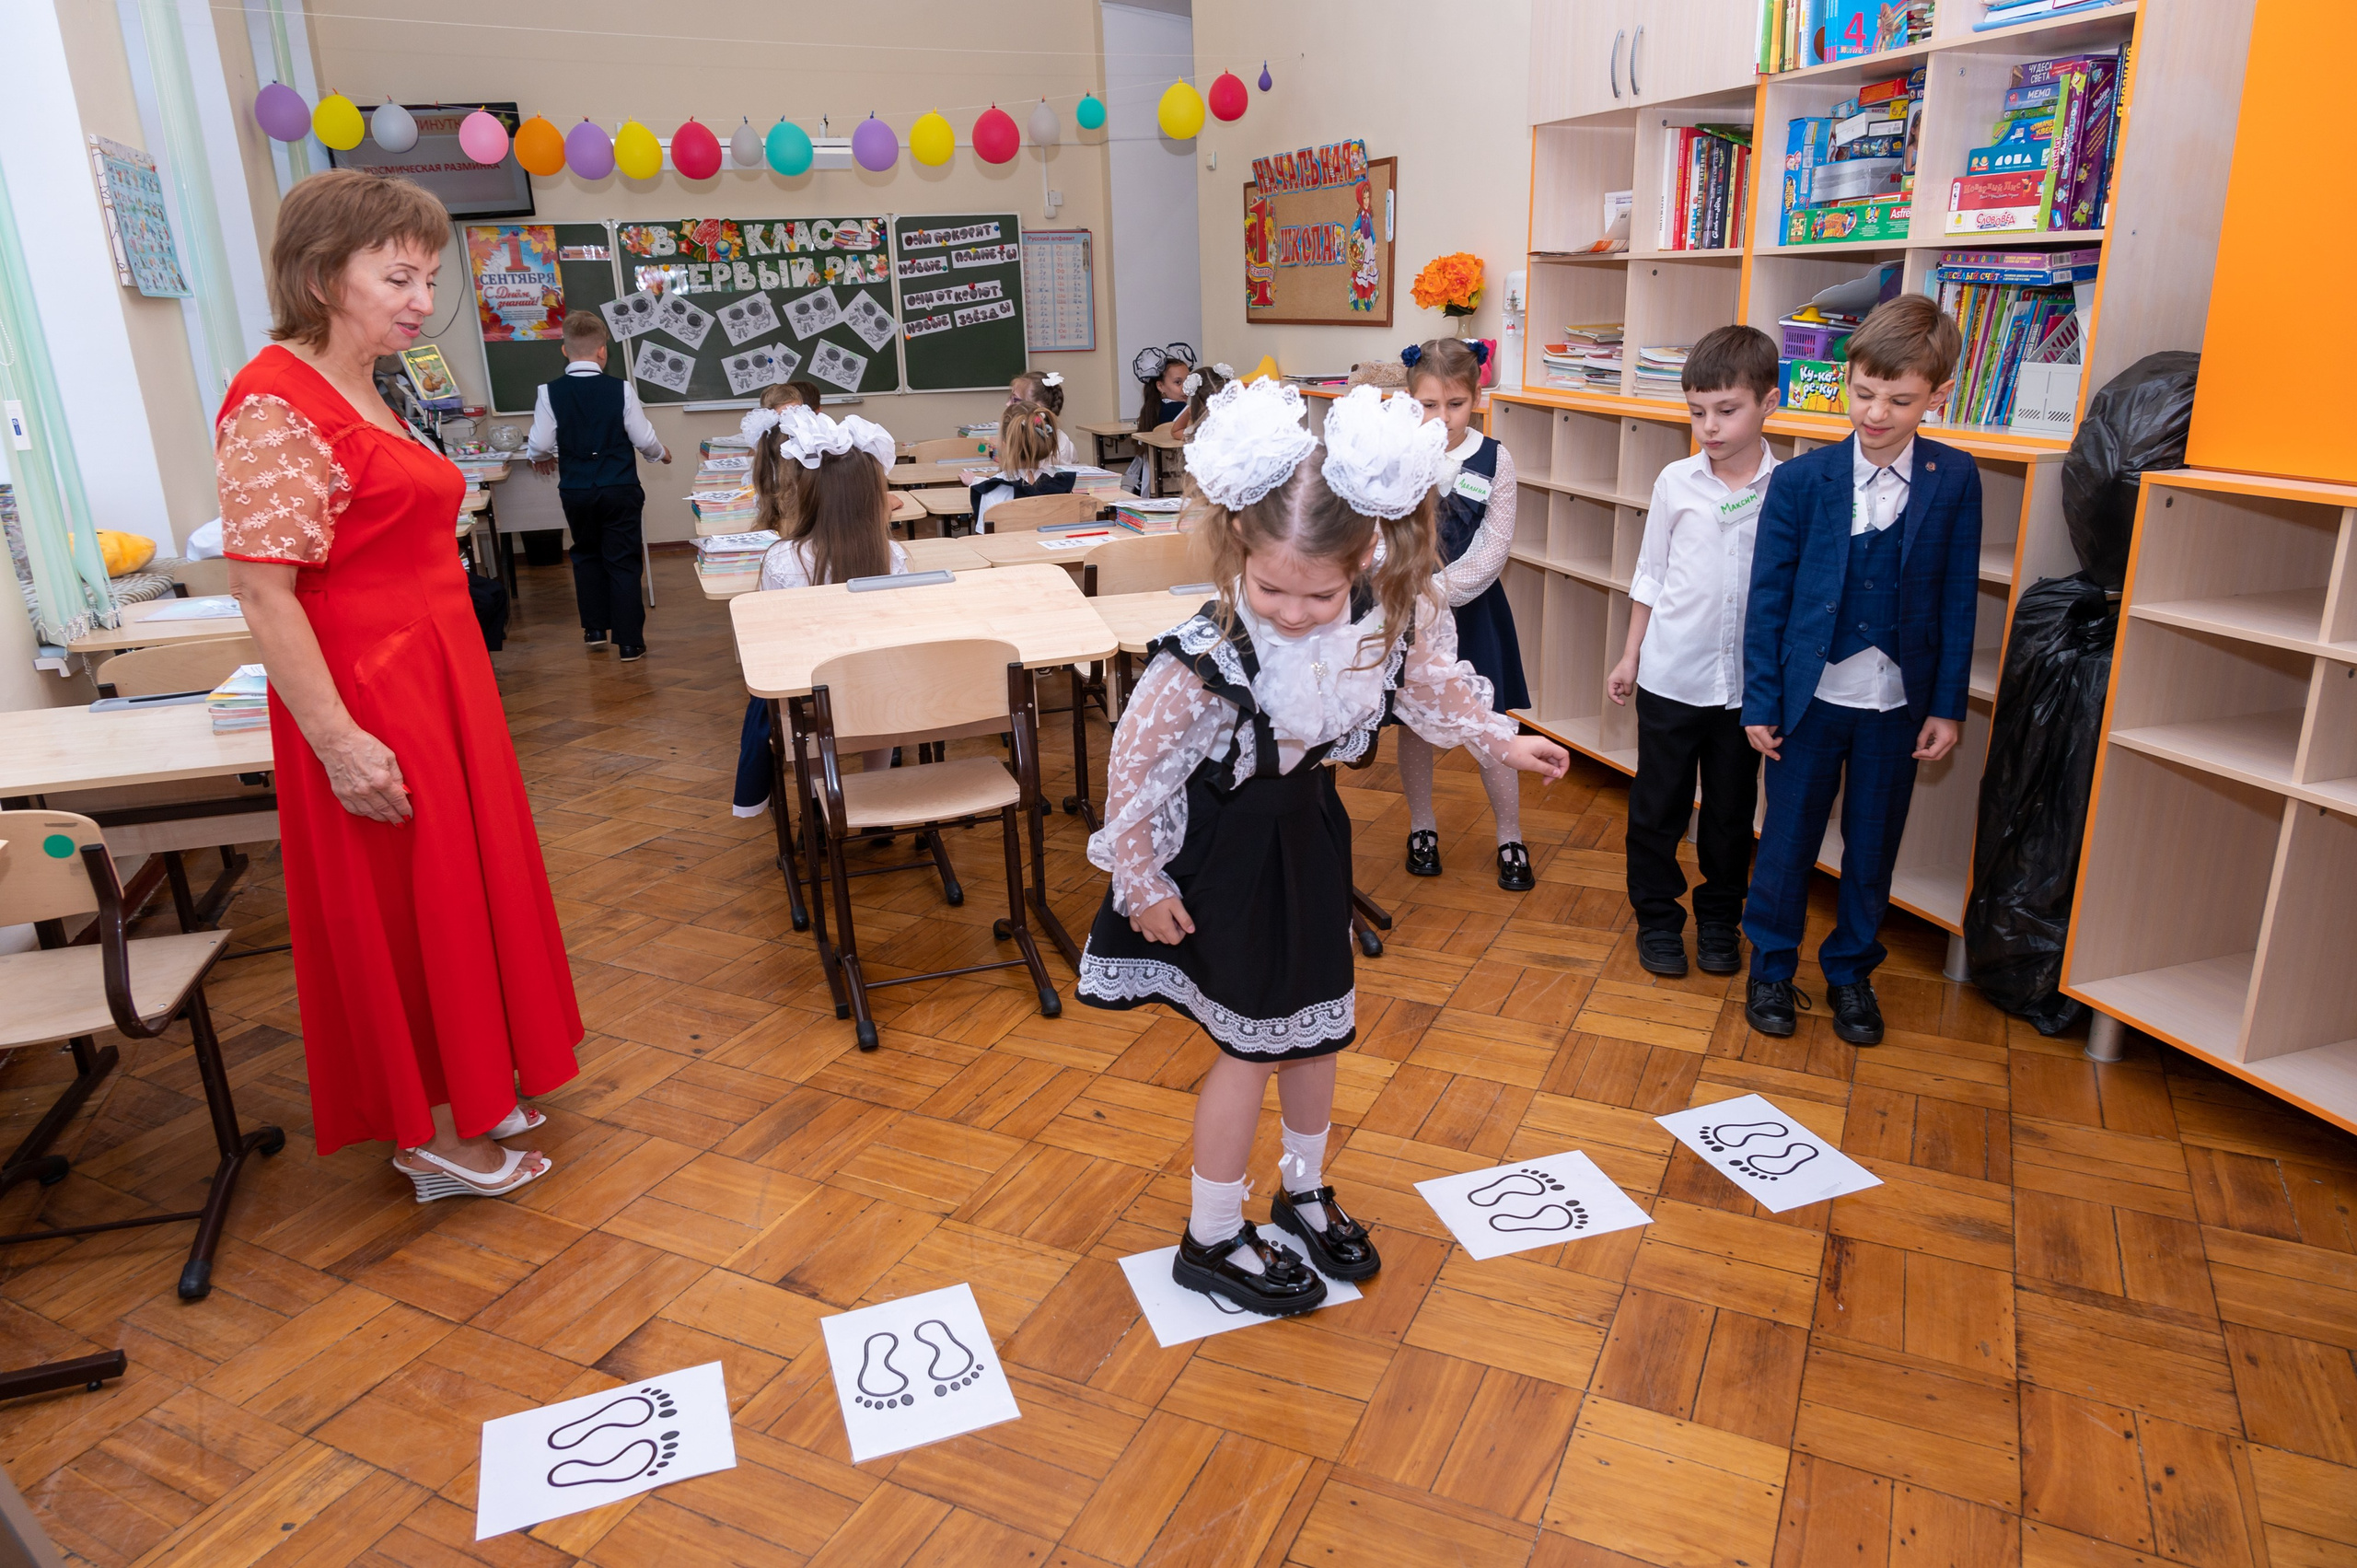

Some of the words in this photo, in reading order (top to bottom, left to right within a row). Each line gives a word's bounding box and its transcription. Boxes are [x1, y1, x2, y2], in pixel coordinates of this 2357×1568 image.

[1844, 12, 1866, 52] 4
[2029, 62, 2052, 73] ЧУДЕСА
[2031, 73, 2049, 84] СВЕТА
[2027, 88, 2050, 99] МЕМО
[2050, 137, 2060, 173] Twister
[445, 163, 501, 172] РАЗМИНКА
[1253, 140, 1353, 195] НАЧАЛЬНАЯ
[649, 226, 677, 256] В
[691, 218, 721, 262] 1
[904, 234, 932, 246] ОНИ
[935, 225, 992, 243] ПОКОРЯТ
[1027, 235, 1050, 243] Русский
[499, 231, 531, 273] 1
[1249, 197, 1274, 306] 1
[825, 254, 887, 285] РАЗ
[898, 260, 942, 275] НОВЫЕ
[954, 249, 1017, 263] ПЛАНЕТЫ
[480, 273, 556, 285] СЕНТЯБРЯ
[1945, 270, 1979, 281] ВЕСЁЛЫЙ
[1980, 272, 2000, 281] СЧЁТ
[483, 286, 494, 299] С
[907, 293, 934, 307] ОНИ
[496, 296, 540, 311] знаний!
[905, 316, 949, 335] НОВЫЕ
[1800, 366, 1837, 383] Ку-ка-
[1803, 383, 1839, 402] ре-ку!
